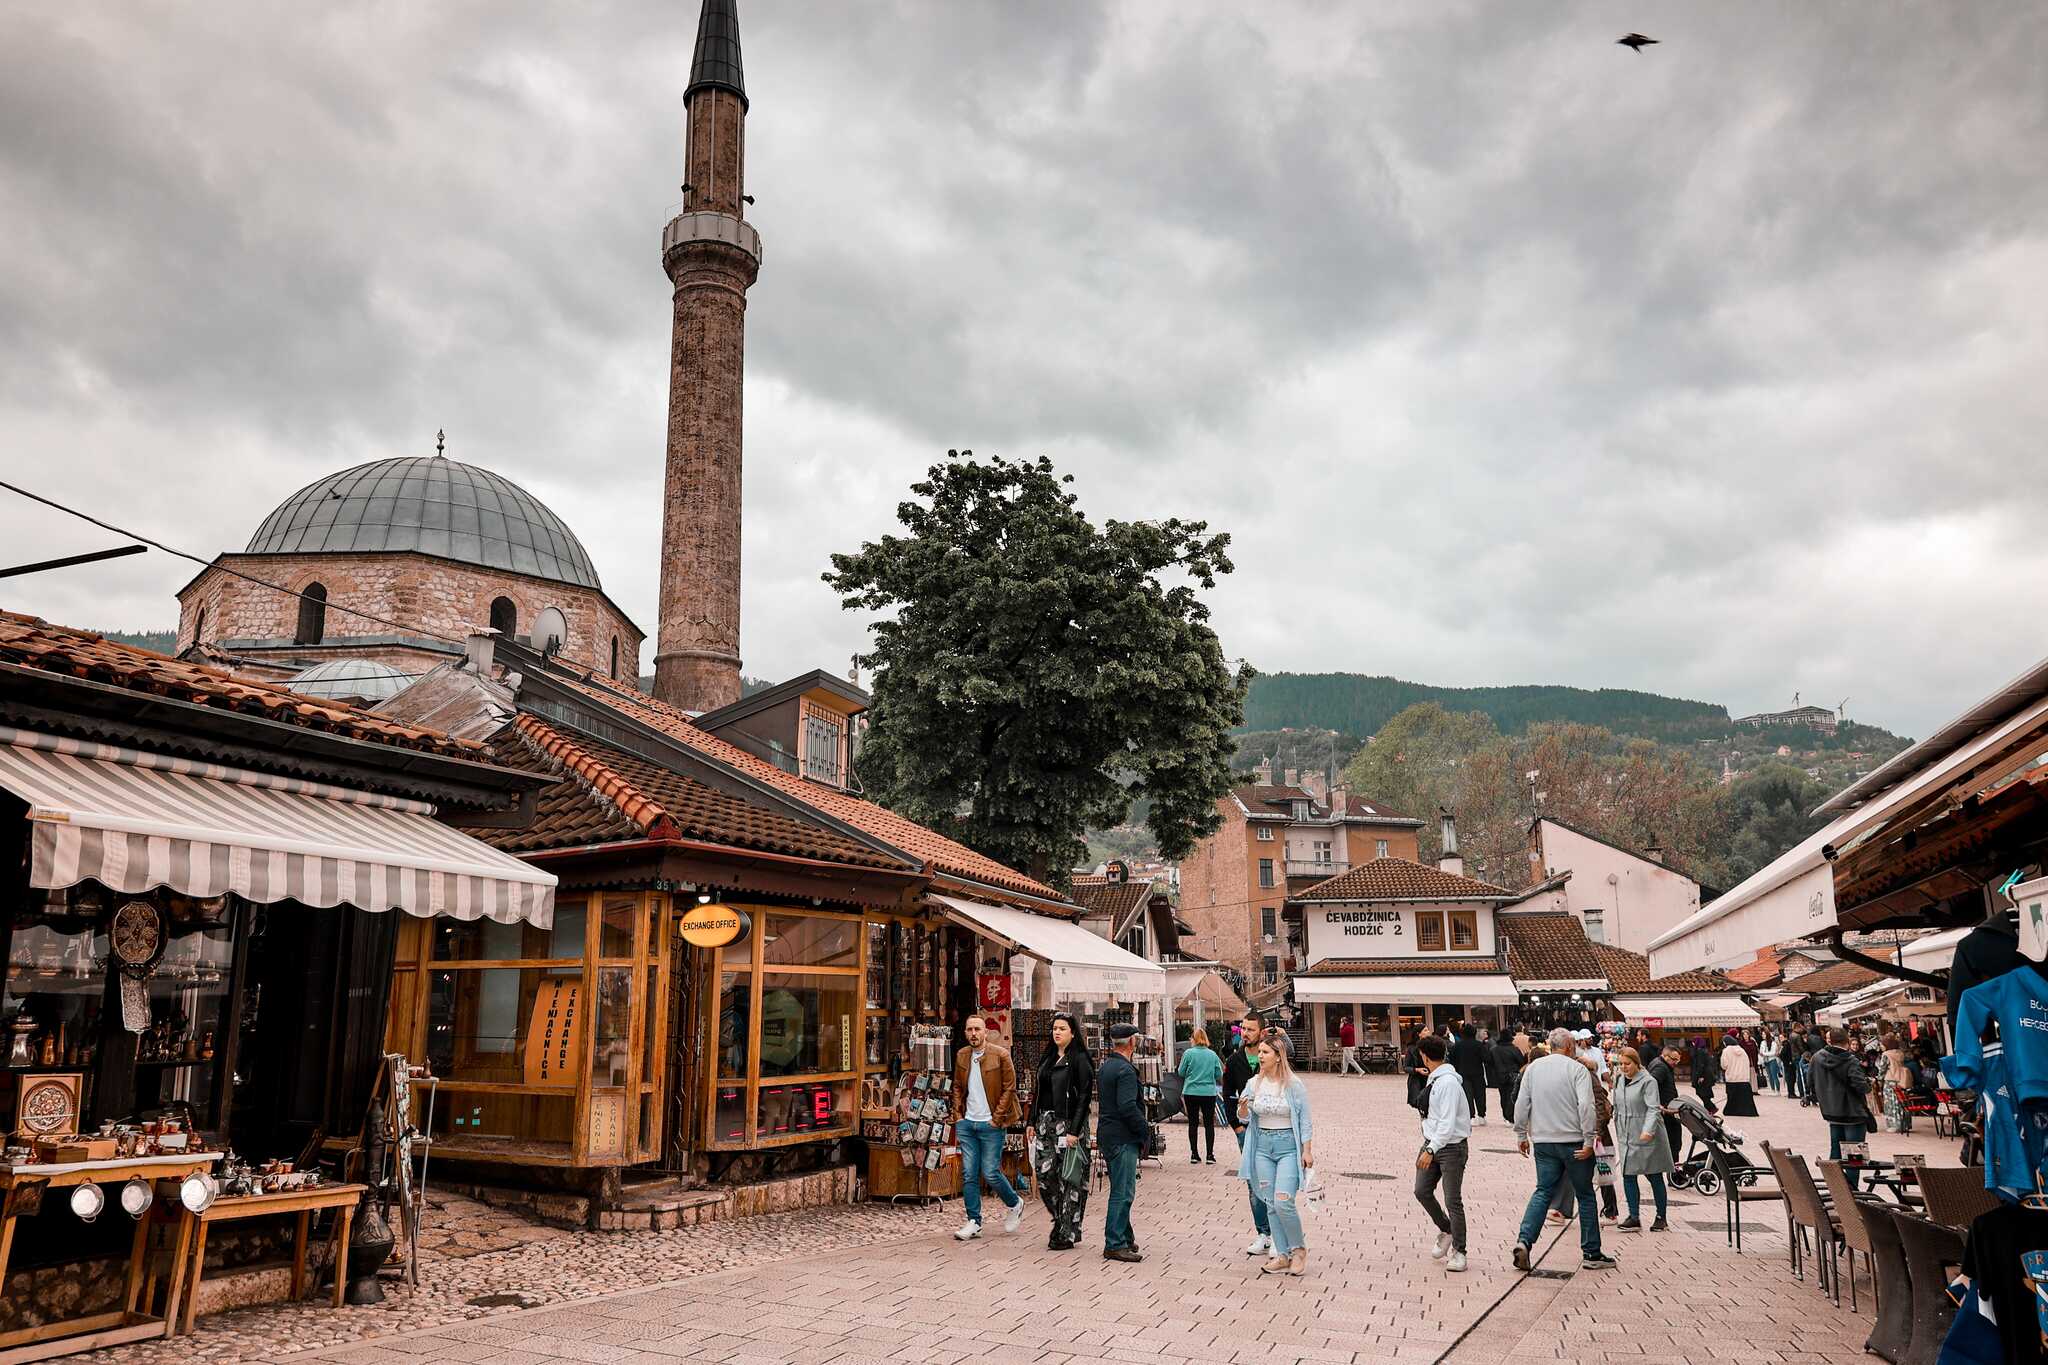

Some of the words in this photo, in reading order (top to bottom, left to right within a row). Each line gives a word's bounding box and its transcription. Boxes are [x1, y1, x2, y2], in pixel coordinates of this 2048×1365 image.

[656, 881, 669, 890] 35
[683, 921, 715, 931] EXCHANGE
[715, 919, 737, 929] OFFICE
[1394, 924, 1403, 936] 2
[559, 988, 577, 1069] EXCHANGE
